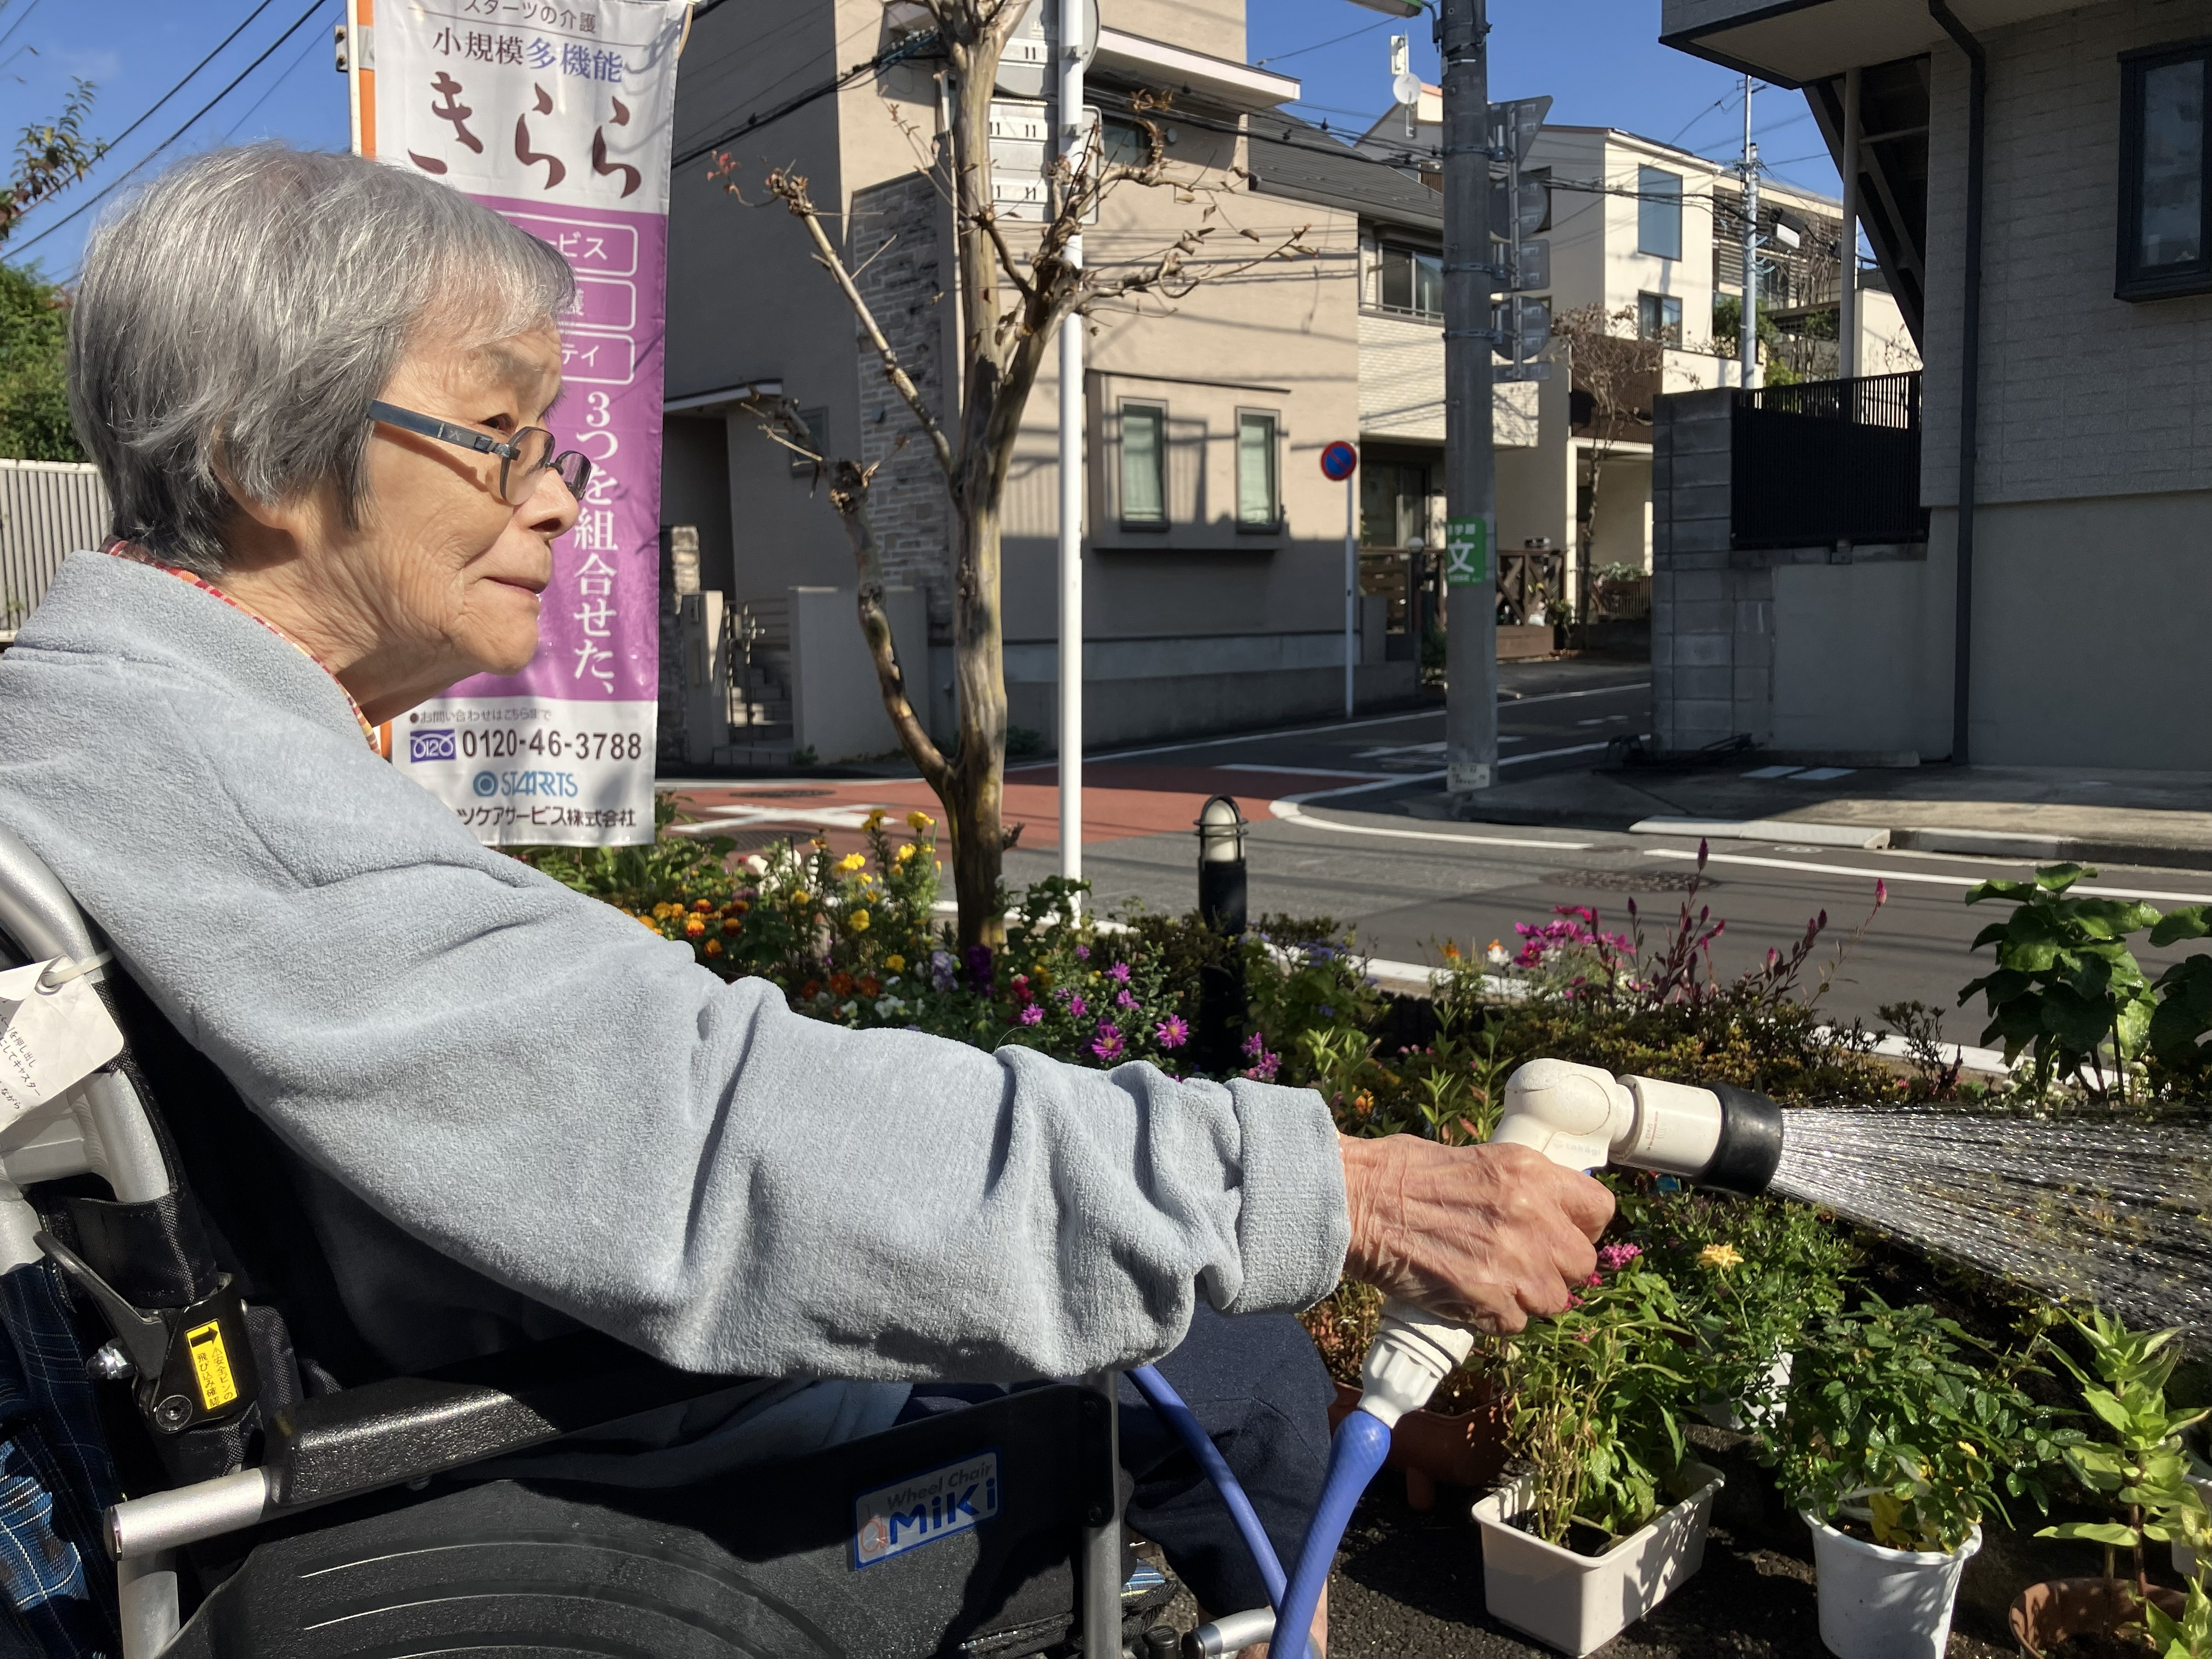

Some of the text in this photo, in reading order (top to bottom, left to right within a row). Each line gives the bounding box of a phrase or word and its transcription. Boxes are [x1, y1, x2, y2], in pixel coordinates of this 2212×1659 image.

[464, 0, 596, 33] スターツの介護
[432, 27, 622, 83] 小規模多機能
[408, 71, 641, 199] きらら
[1447, 538, 1475, 573] 文
[462, 729, 642, 760] 0120-46-3788
[887, 1461, 994, 1509] Wheel Chair
